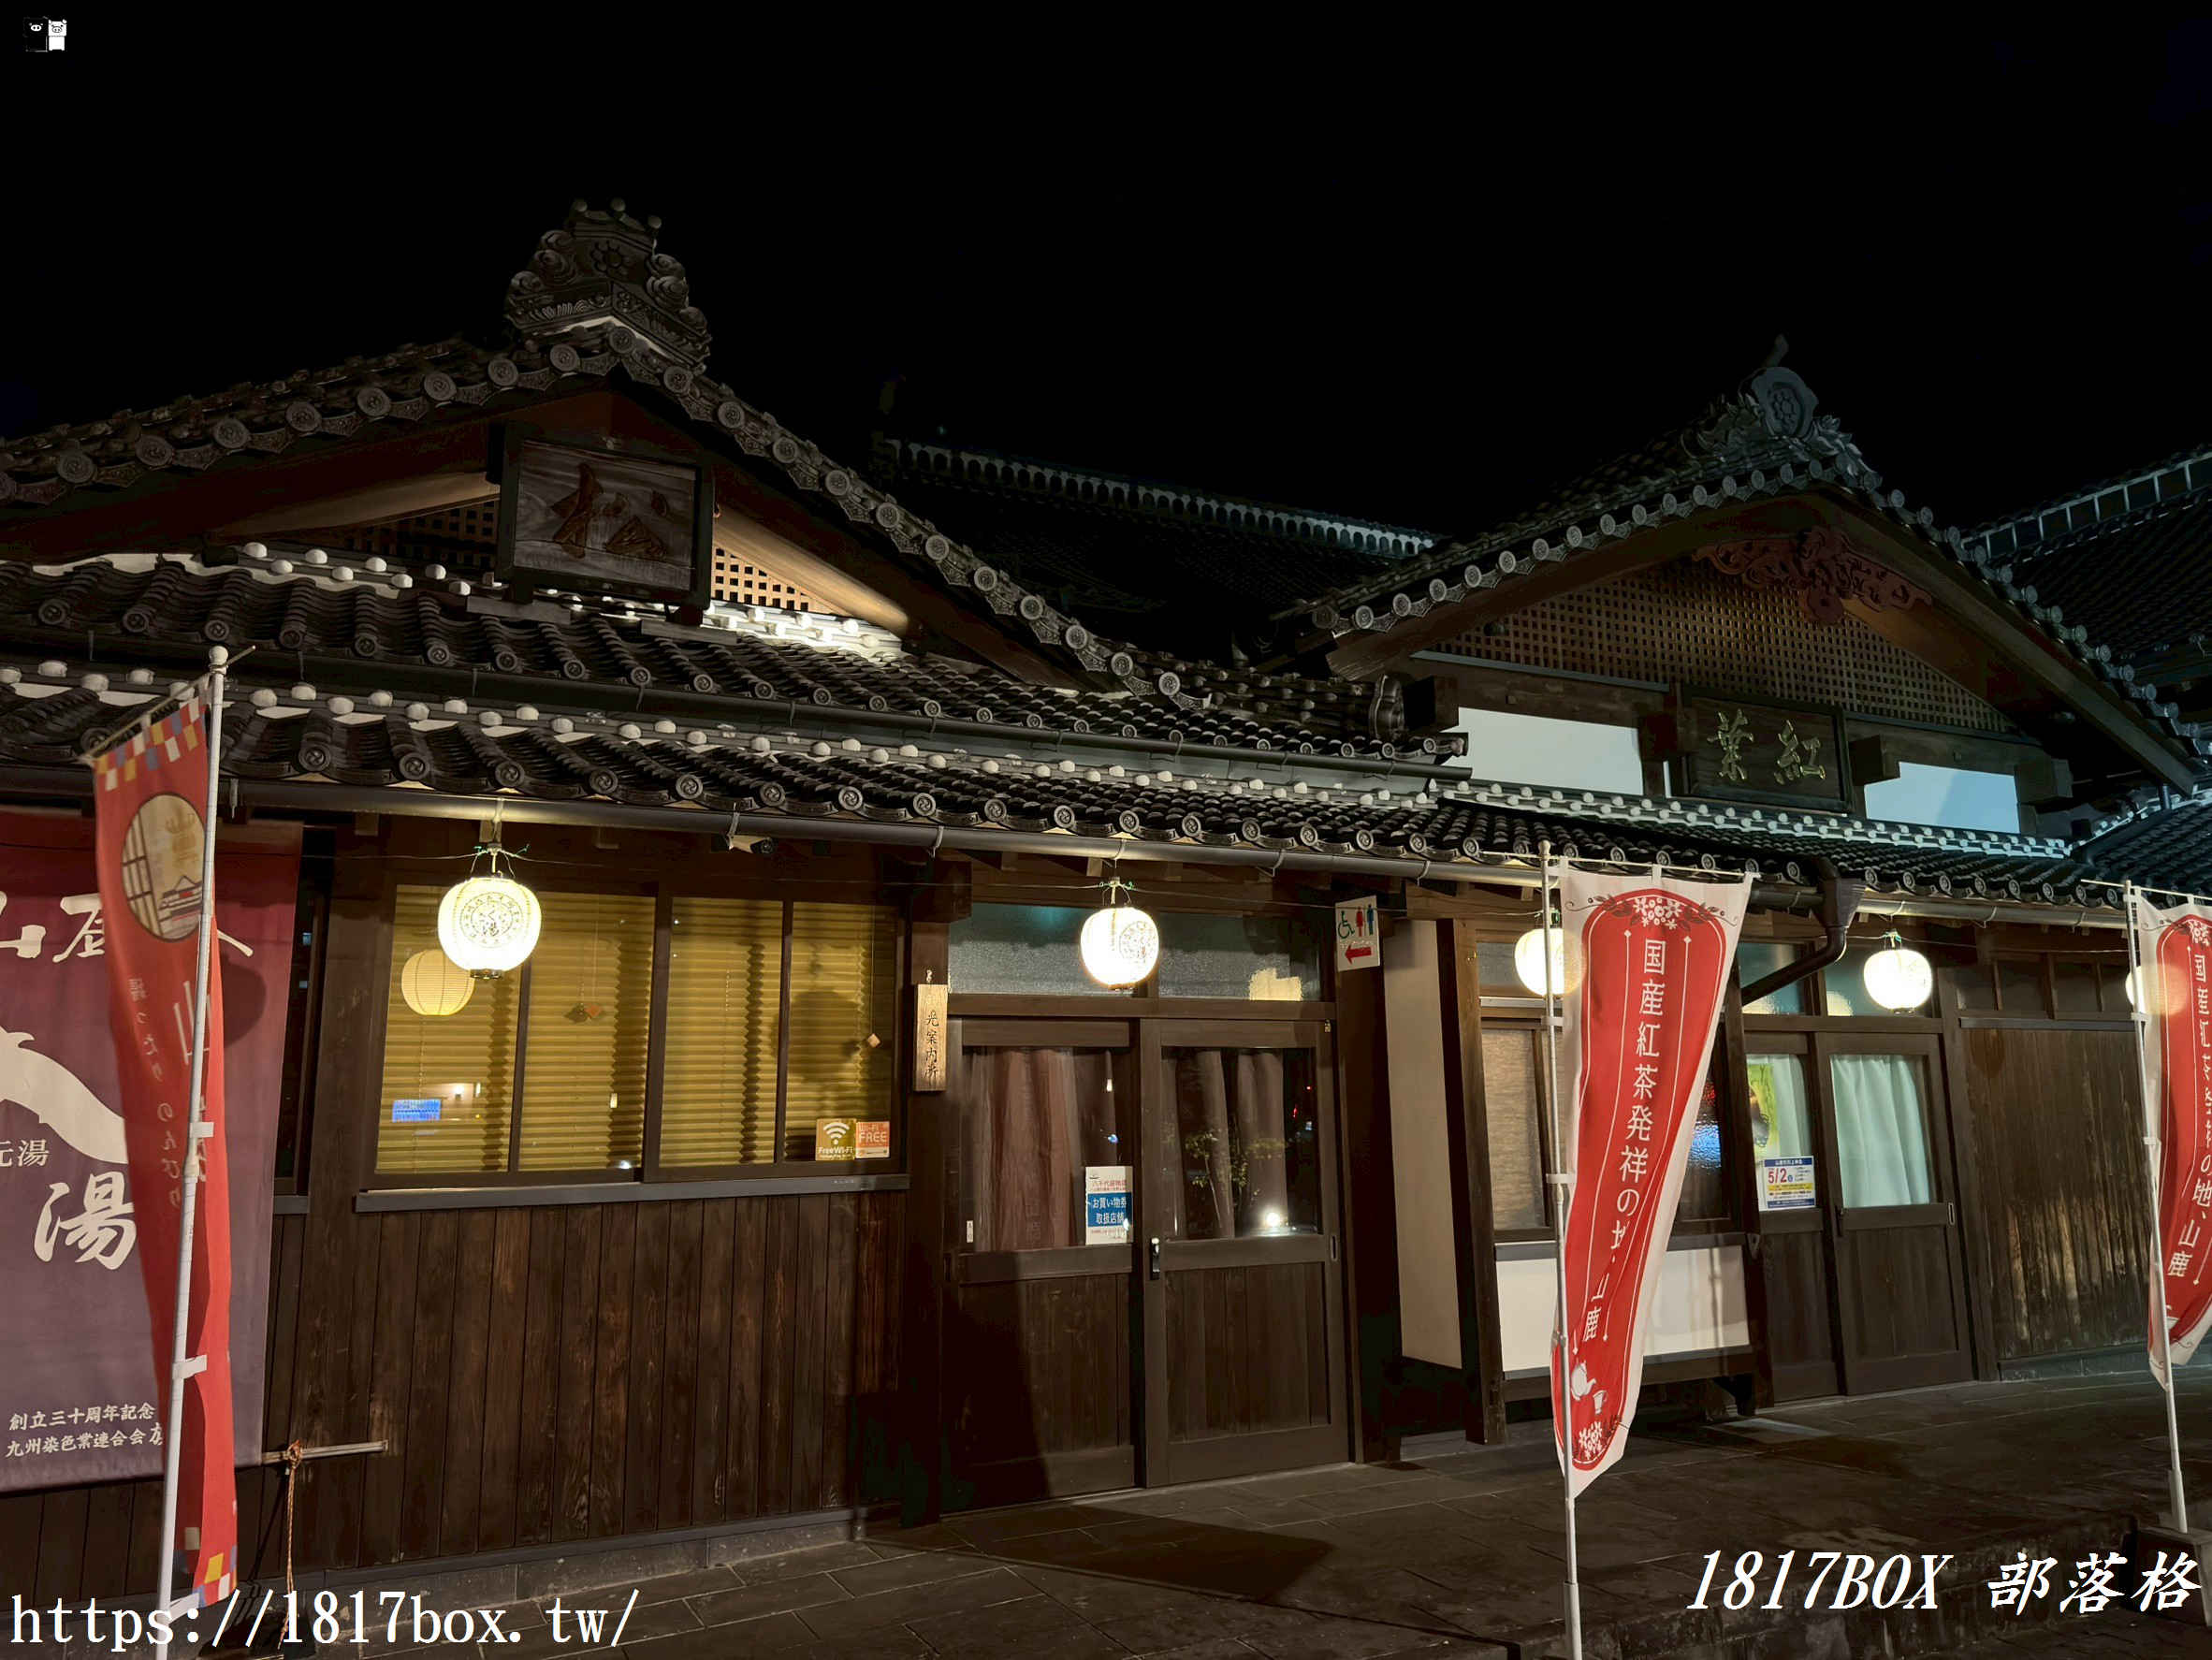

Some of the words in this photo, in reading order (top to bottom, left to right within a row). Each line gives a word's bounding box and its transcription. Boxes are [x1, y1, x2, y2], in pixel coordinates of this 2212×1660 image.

[924, 994, 939, 1086] 光案内所
[858, 1131, 887, 1143] FREE
[1768, 1167, 1787, 1184] 5/2
[34, 1171, 138, 1271] 湯
[8, 1402, 156, 1431] 創立三十周年記念
